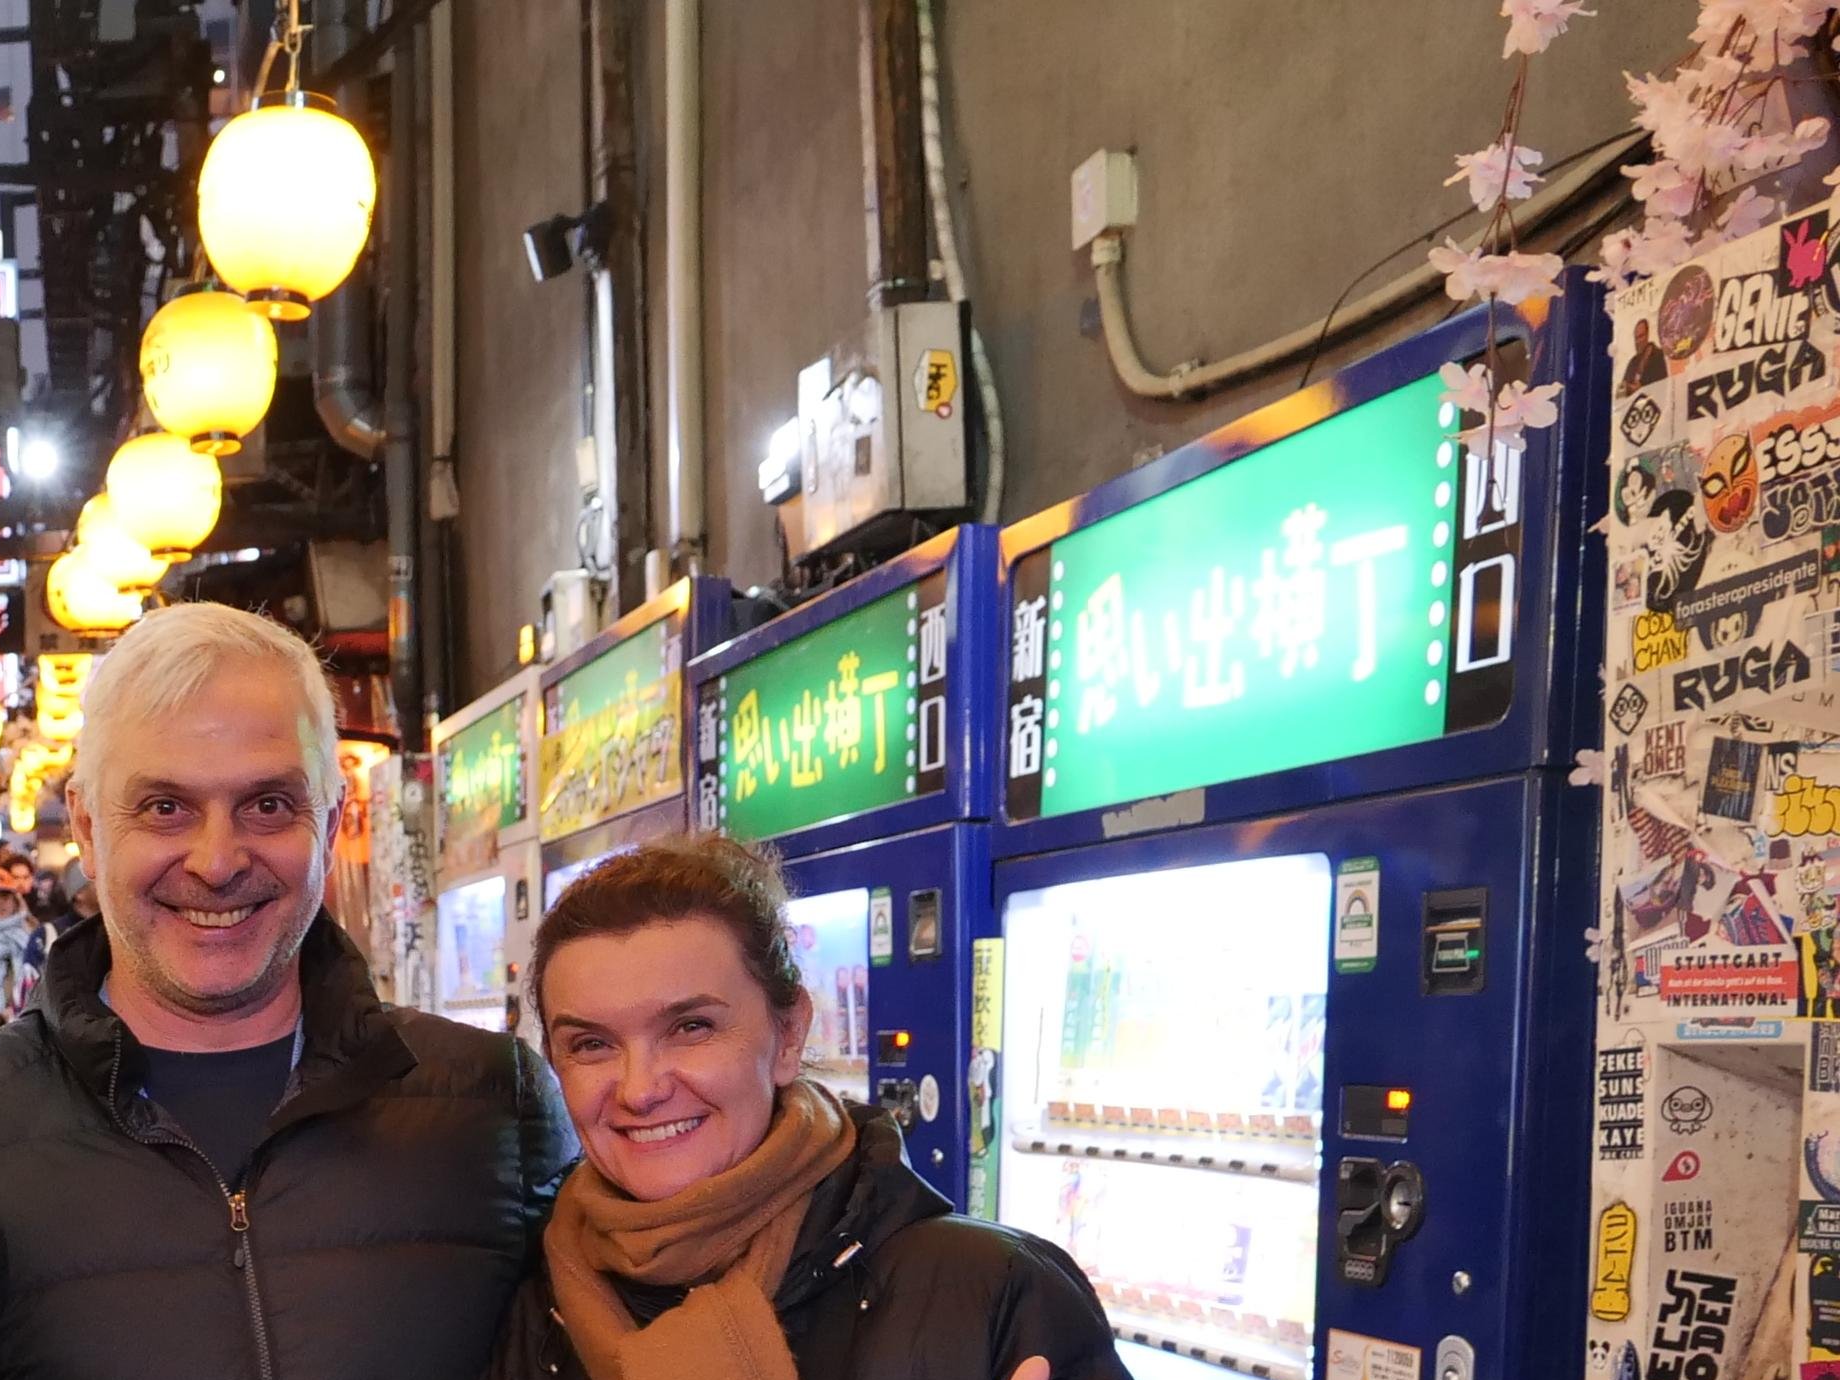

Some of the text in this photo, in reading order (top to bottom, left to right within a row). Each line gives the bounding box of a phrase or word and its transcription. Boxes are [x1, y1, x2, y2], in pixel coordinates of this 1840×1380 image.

[1687, 340, 1826, 420] RUGA
[1456, 438, 1524, 673] 西口
[1077, 502, 1408, 733] 思い出横丁
[920, 603, 946, 772] 西口
[1009, 596, 1046, 779] 新宿
[1673, 641, 1810, 711] RUGA
[733, 651, 898, 802] 思い出横丁
[1667, 992, 1787, 1008] INTERNATIONAL
[1675, 952, 1781, 970] STUTTGART
[1599, 1077, 1644, 1095] SUNS
[1664, 1229, 1712, 1253] BTM
